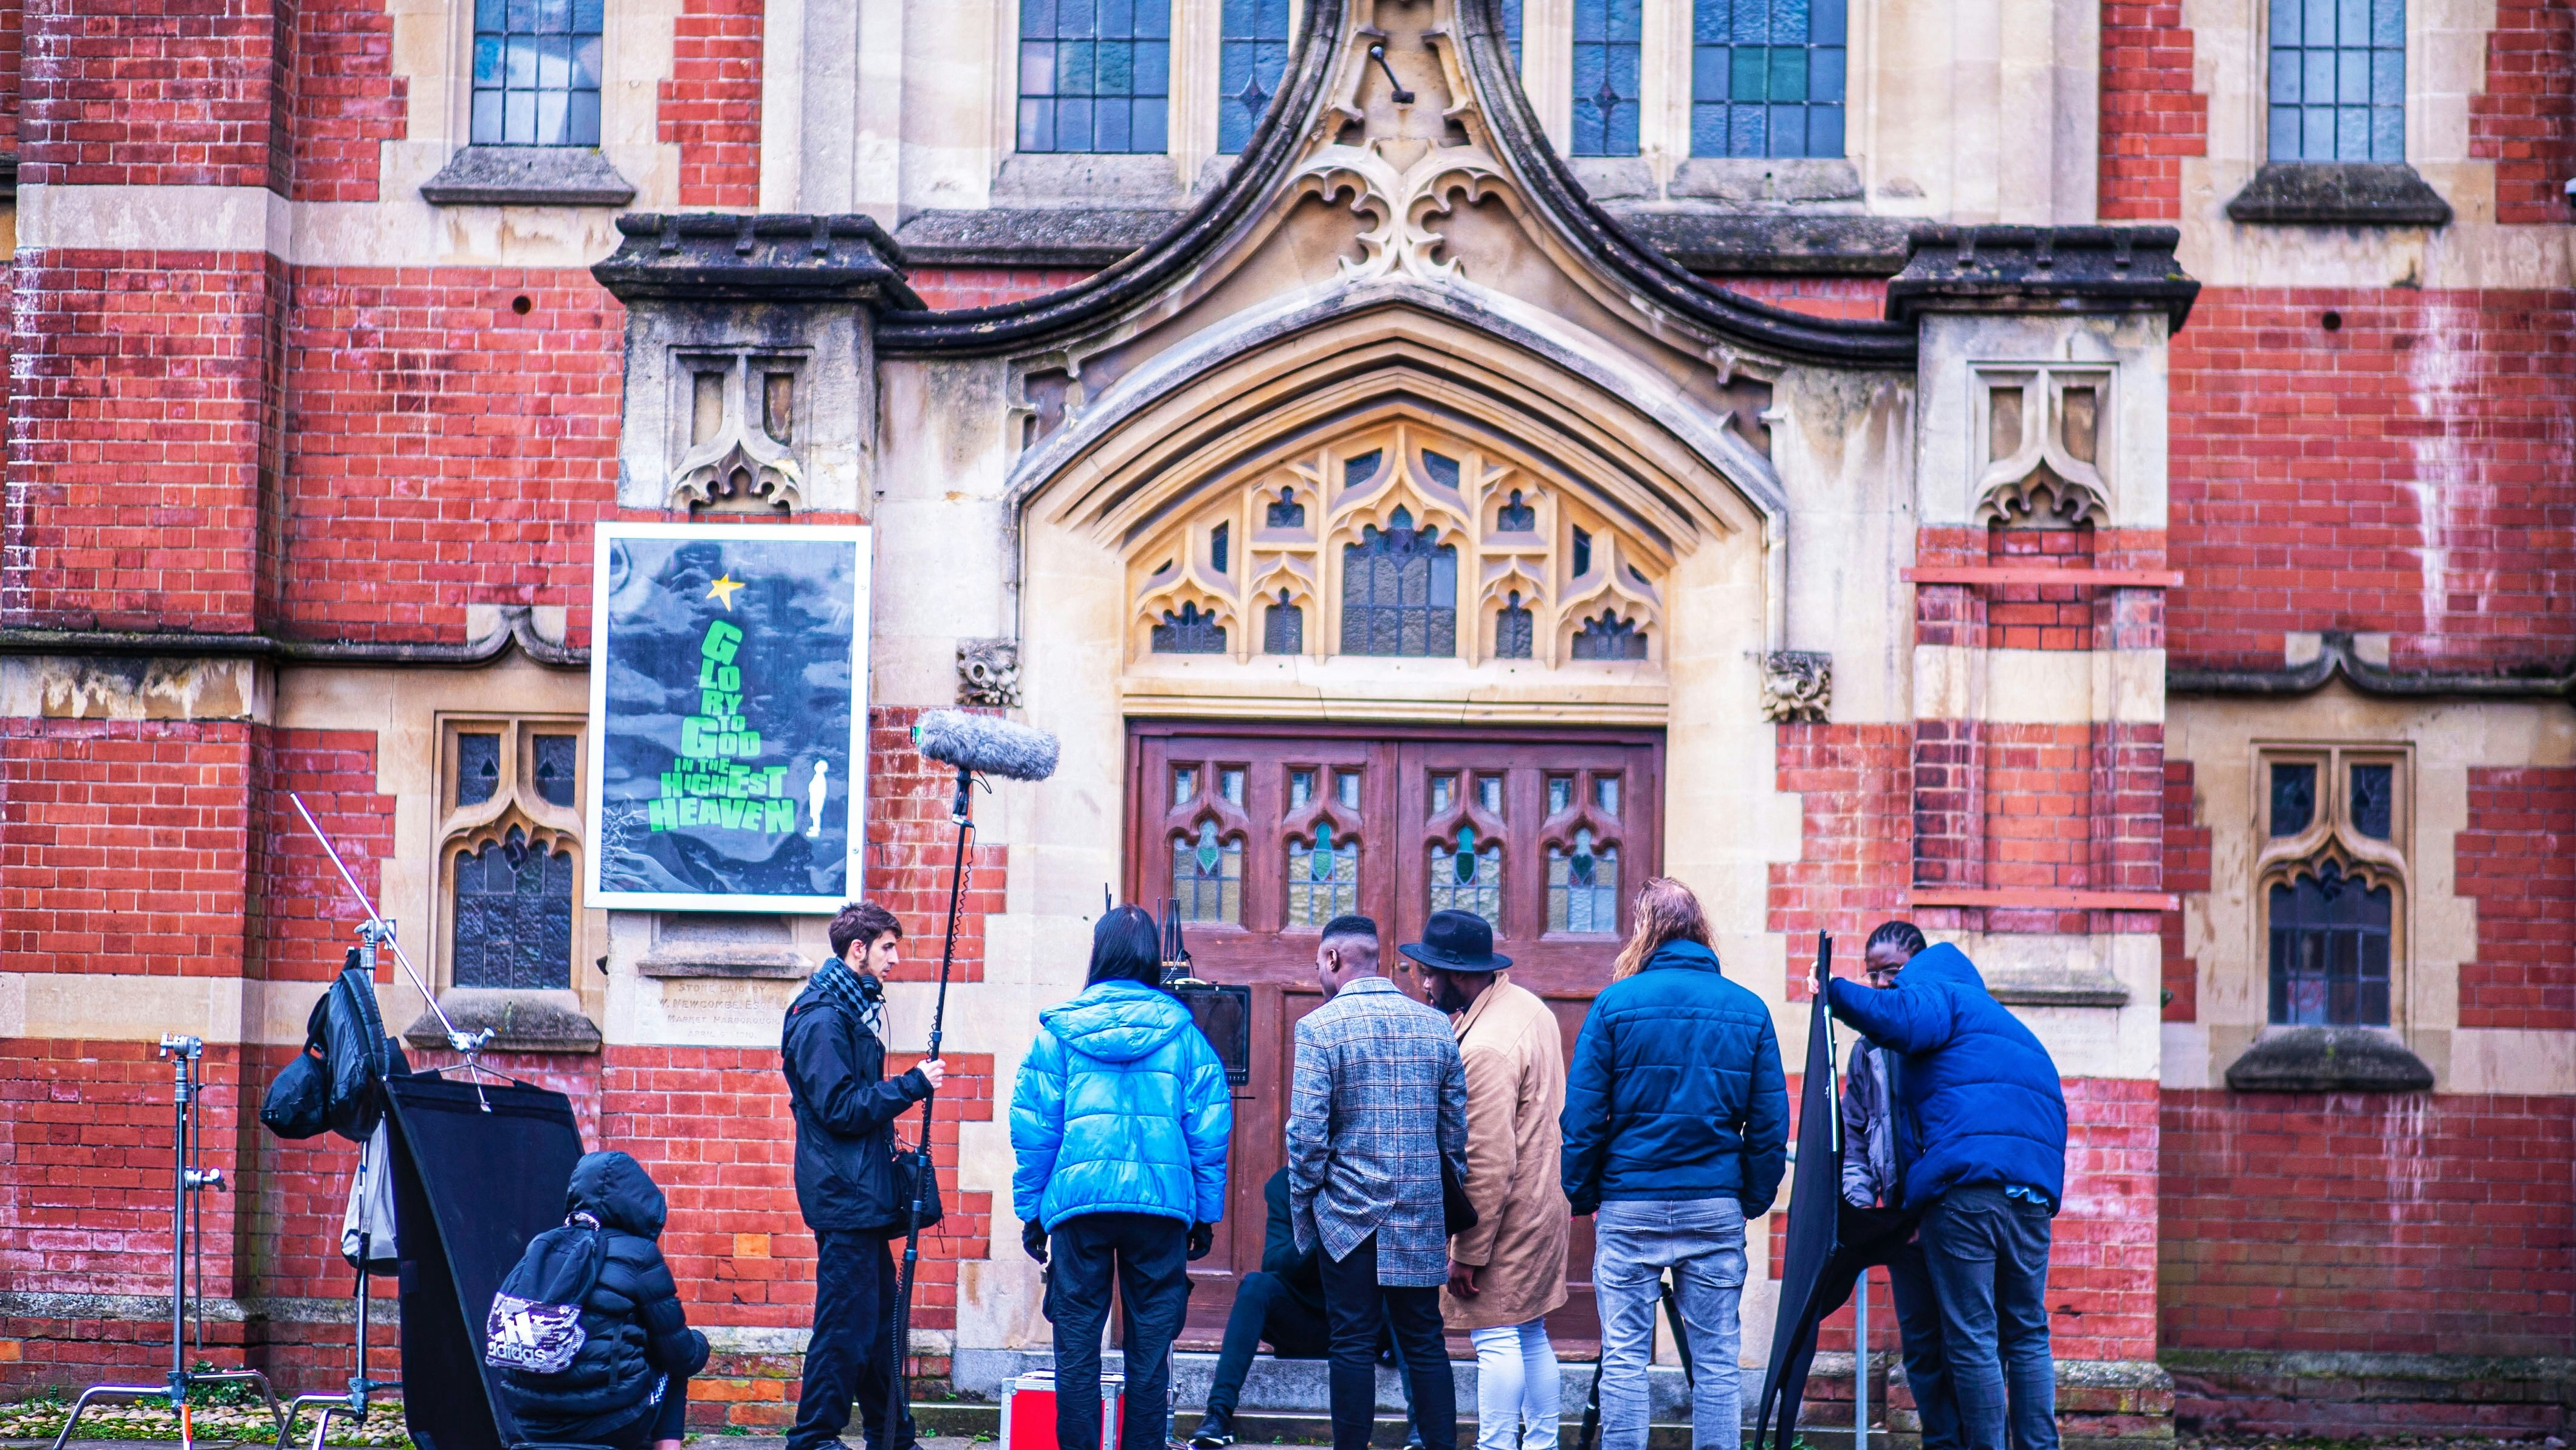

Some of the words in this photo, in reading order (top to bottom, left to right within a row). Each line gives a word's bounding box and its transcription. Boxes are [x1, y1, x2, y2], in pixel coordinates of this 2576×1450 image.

[718, 715, 746, 732] TO
[681, 716, 761, 759] GOD
[674, 758, 694, 772] IN
[696, 758, 729, 774] THE
[661, 765, 787, 799] HIGHEST
[648, 797, 795, 833] HEAVEN
[678, 983, 715, 993] STONE
[720, 984, 744, 993] LAID
[752, 985, 766, 994] BY
[668, 1015, 706, 1024] MARKET
[488, 1341, 546, 1363] adidas
